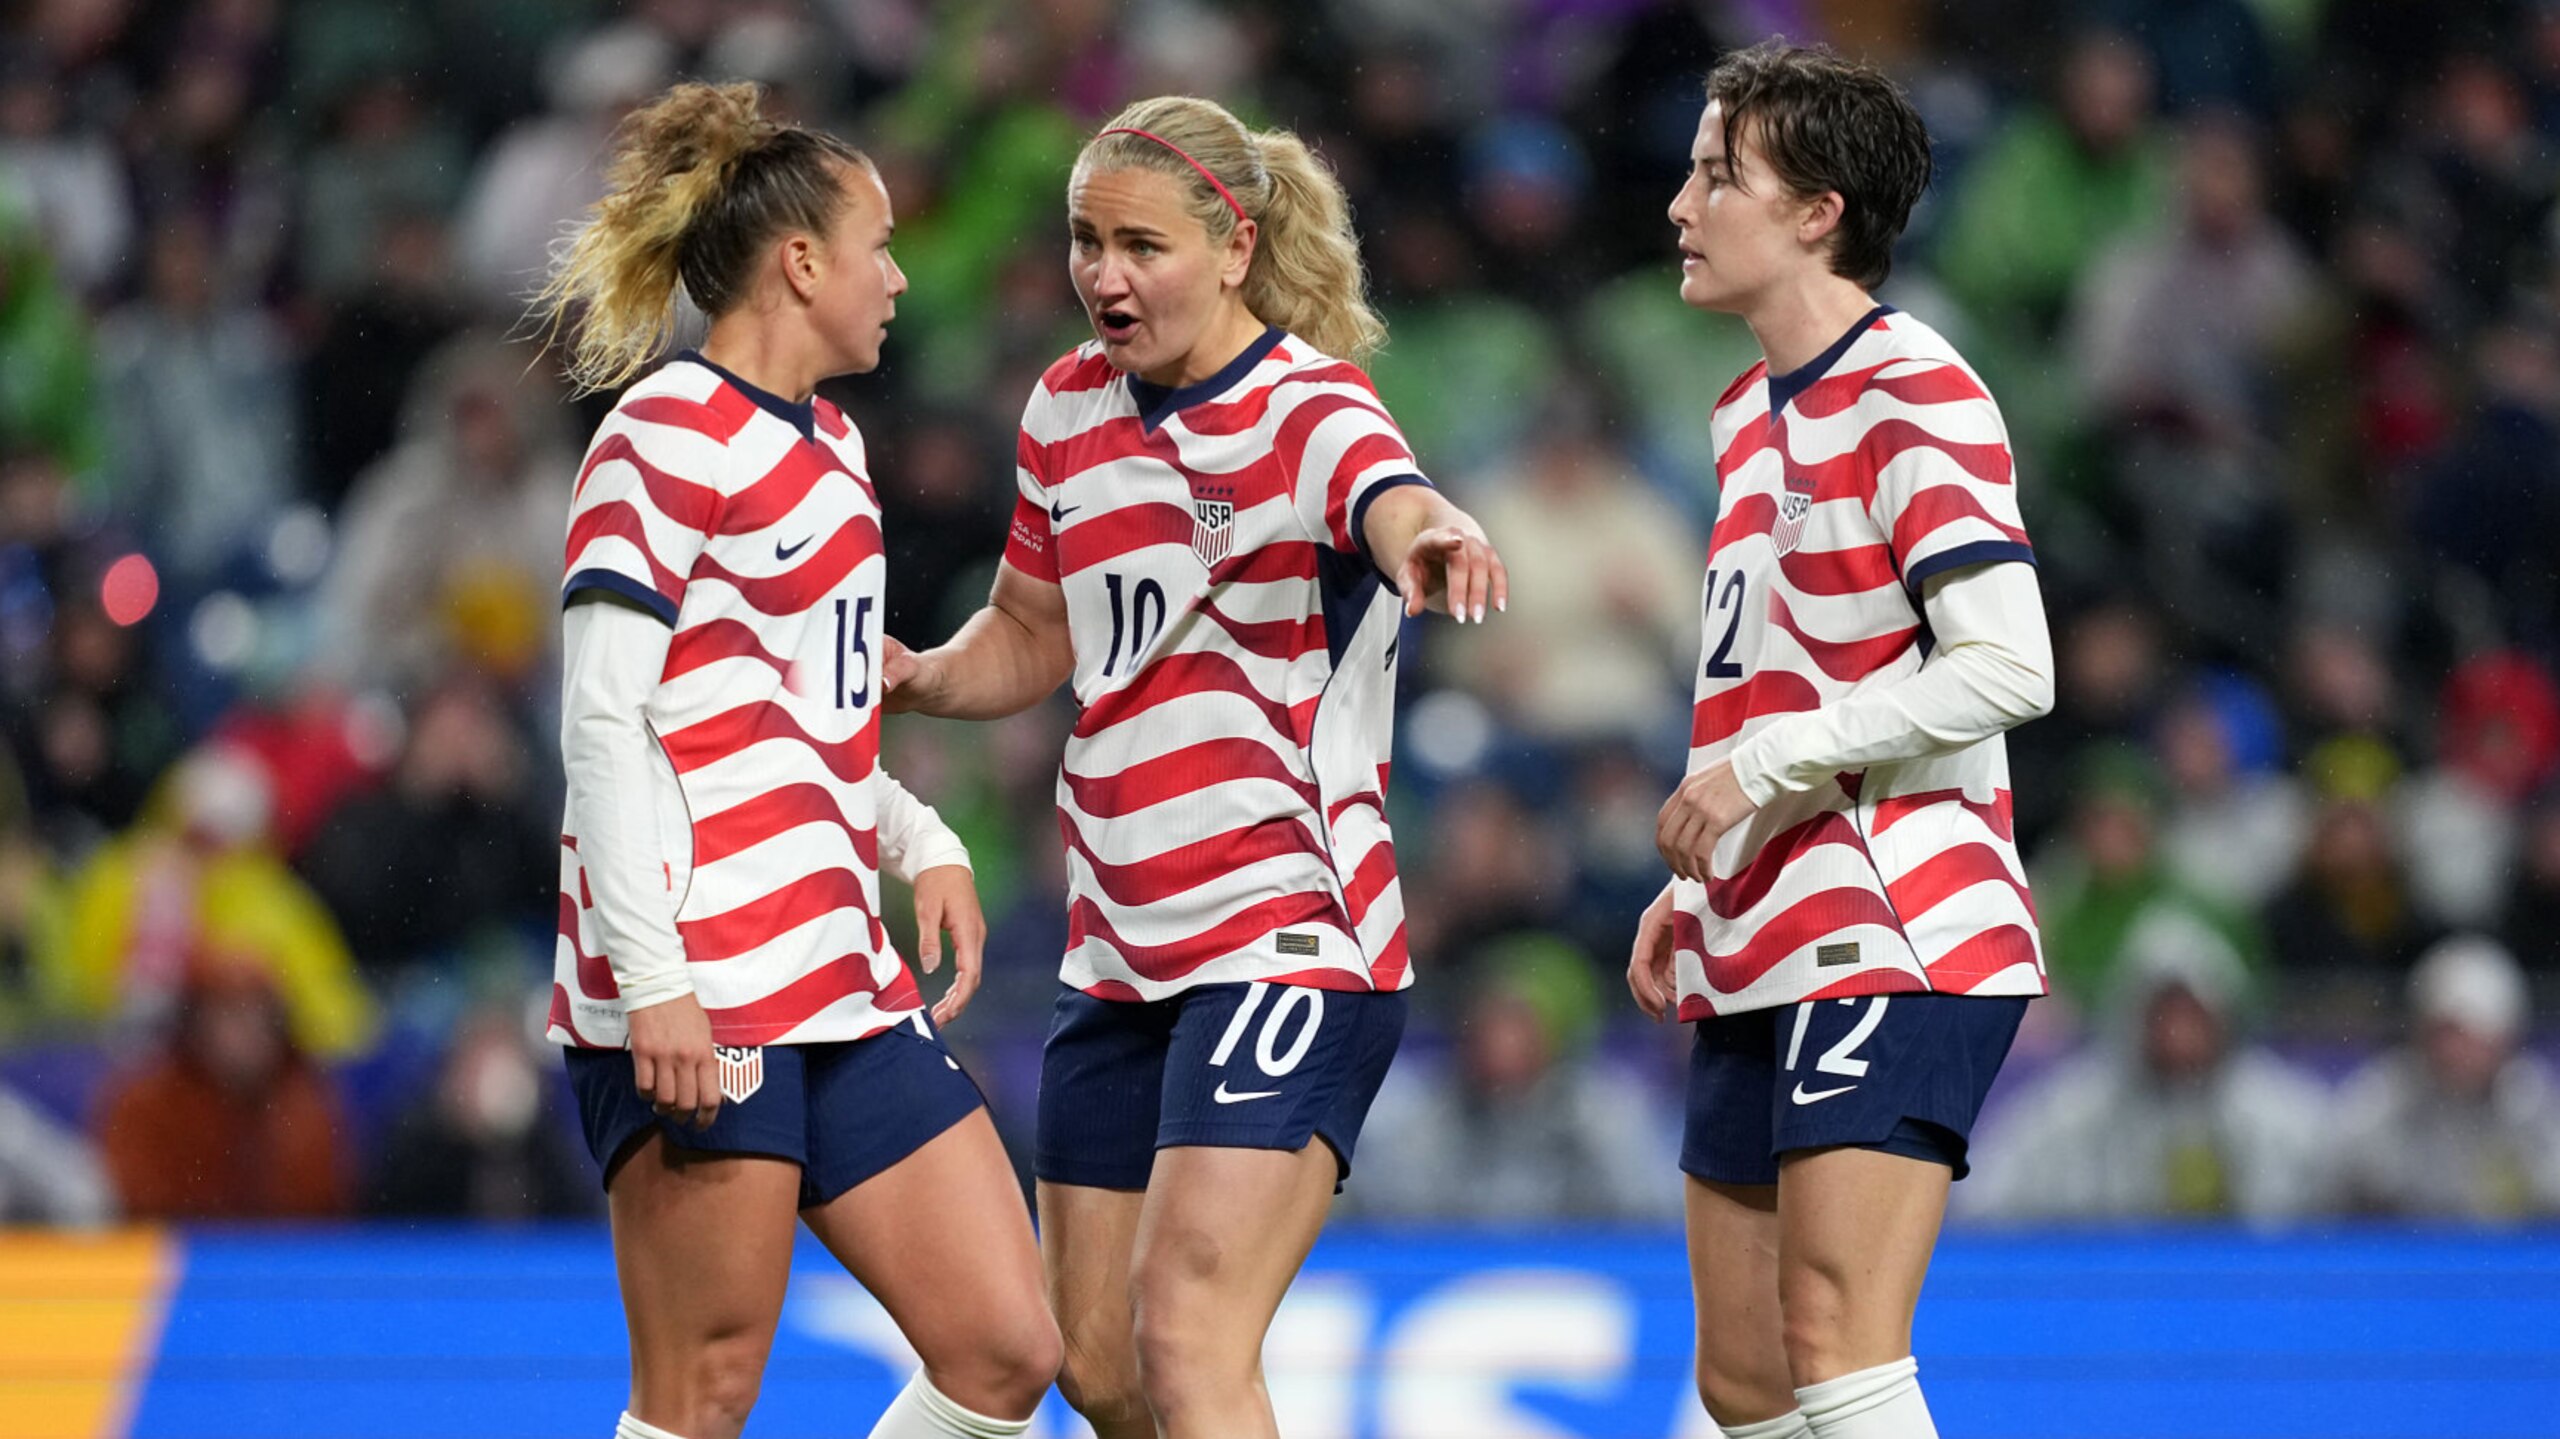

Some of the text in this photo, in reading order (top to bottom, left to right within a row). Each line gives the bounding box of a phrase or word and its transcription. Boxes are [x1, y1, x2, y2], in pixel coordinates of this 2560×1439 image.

[1197, 502, 1231, 529] USA
[1782, 494, 1809, 520] USA
[835, 597, 873, 709] 15
[1102, 573, 1166, 677] 10
[1209, 982, 1324, 1077] 10
[1785, 995, 1890, 1077] 12
